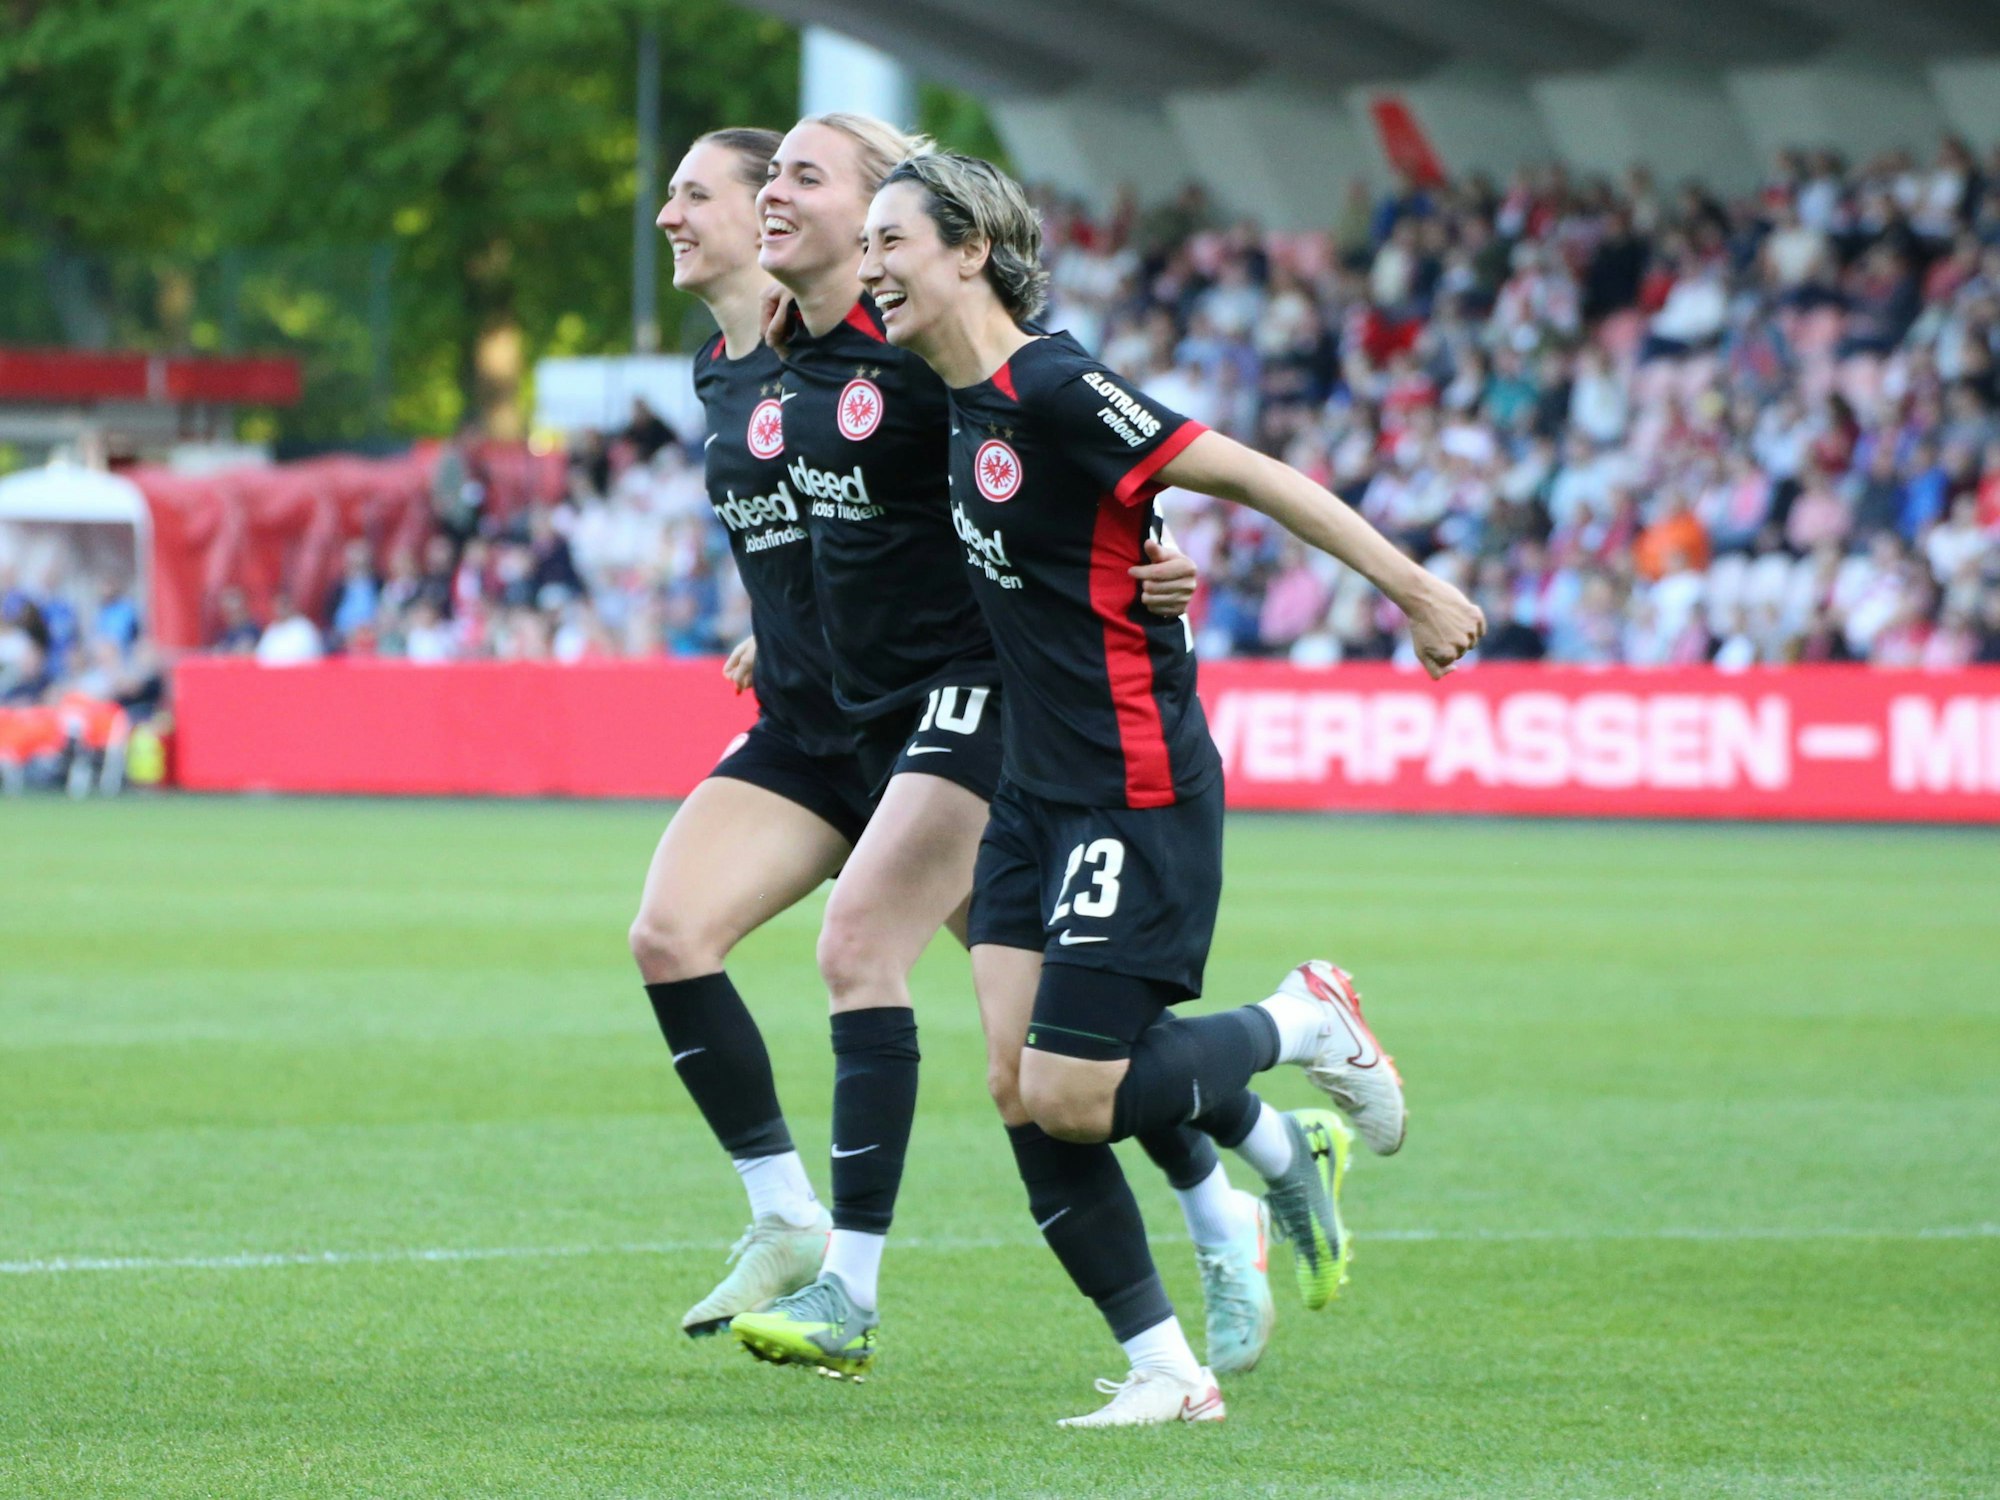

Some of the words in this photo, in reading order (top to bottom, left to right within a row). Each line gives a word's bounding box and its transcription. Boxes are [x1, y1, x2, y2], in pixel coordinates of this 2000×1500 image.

[1082, 372, 1161, 438] ELOTRANS
[1097, 407, 1147, 447] reload
[1048, 838, 1125, 925] 23
